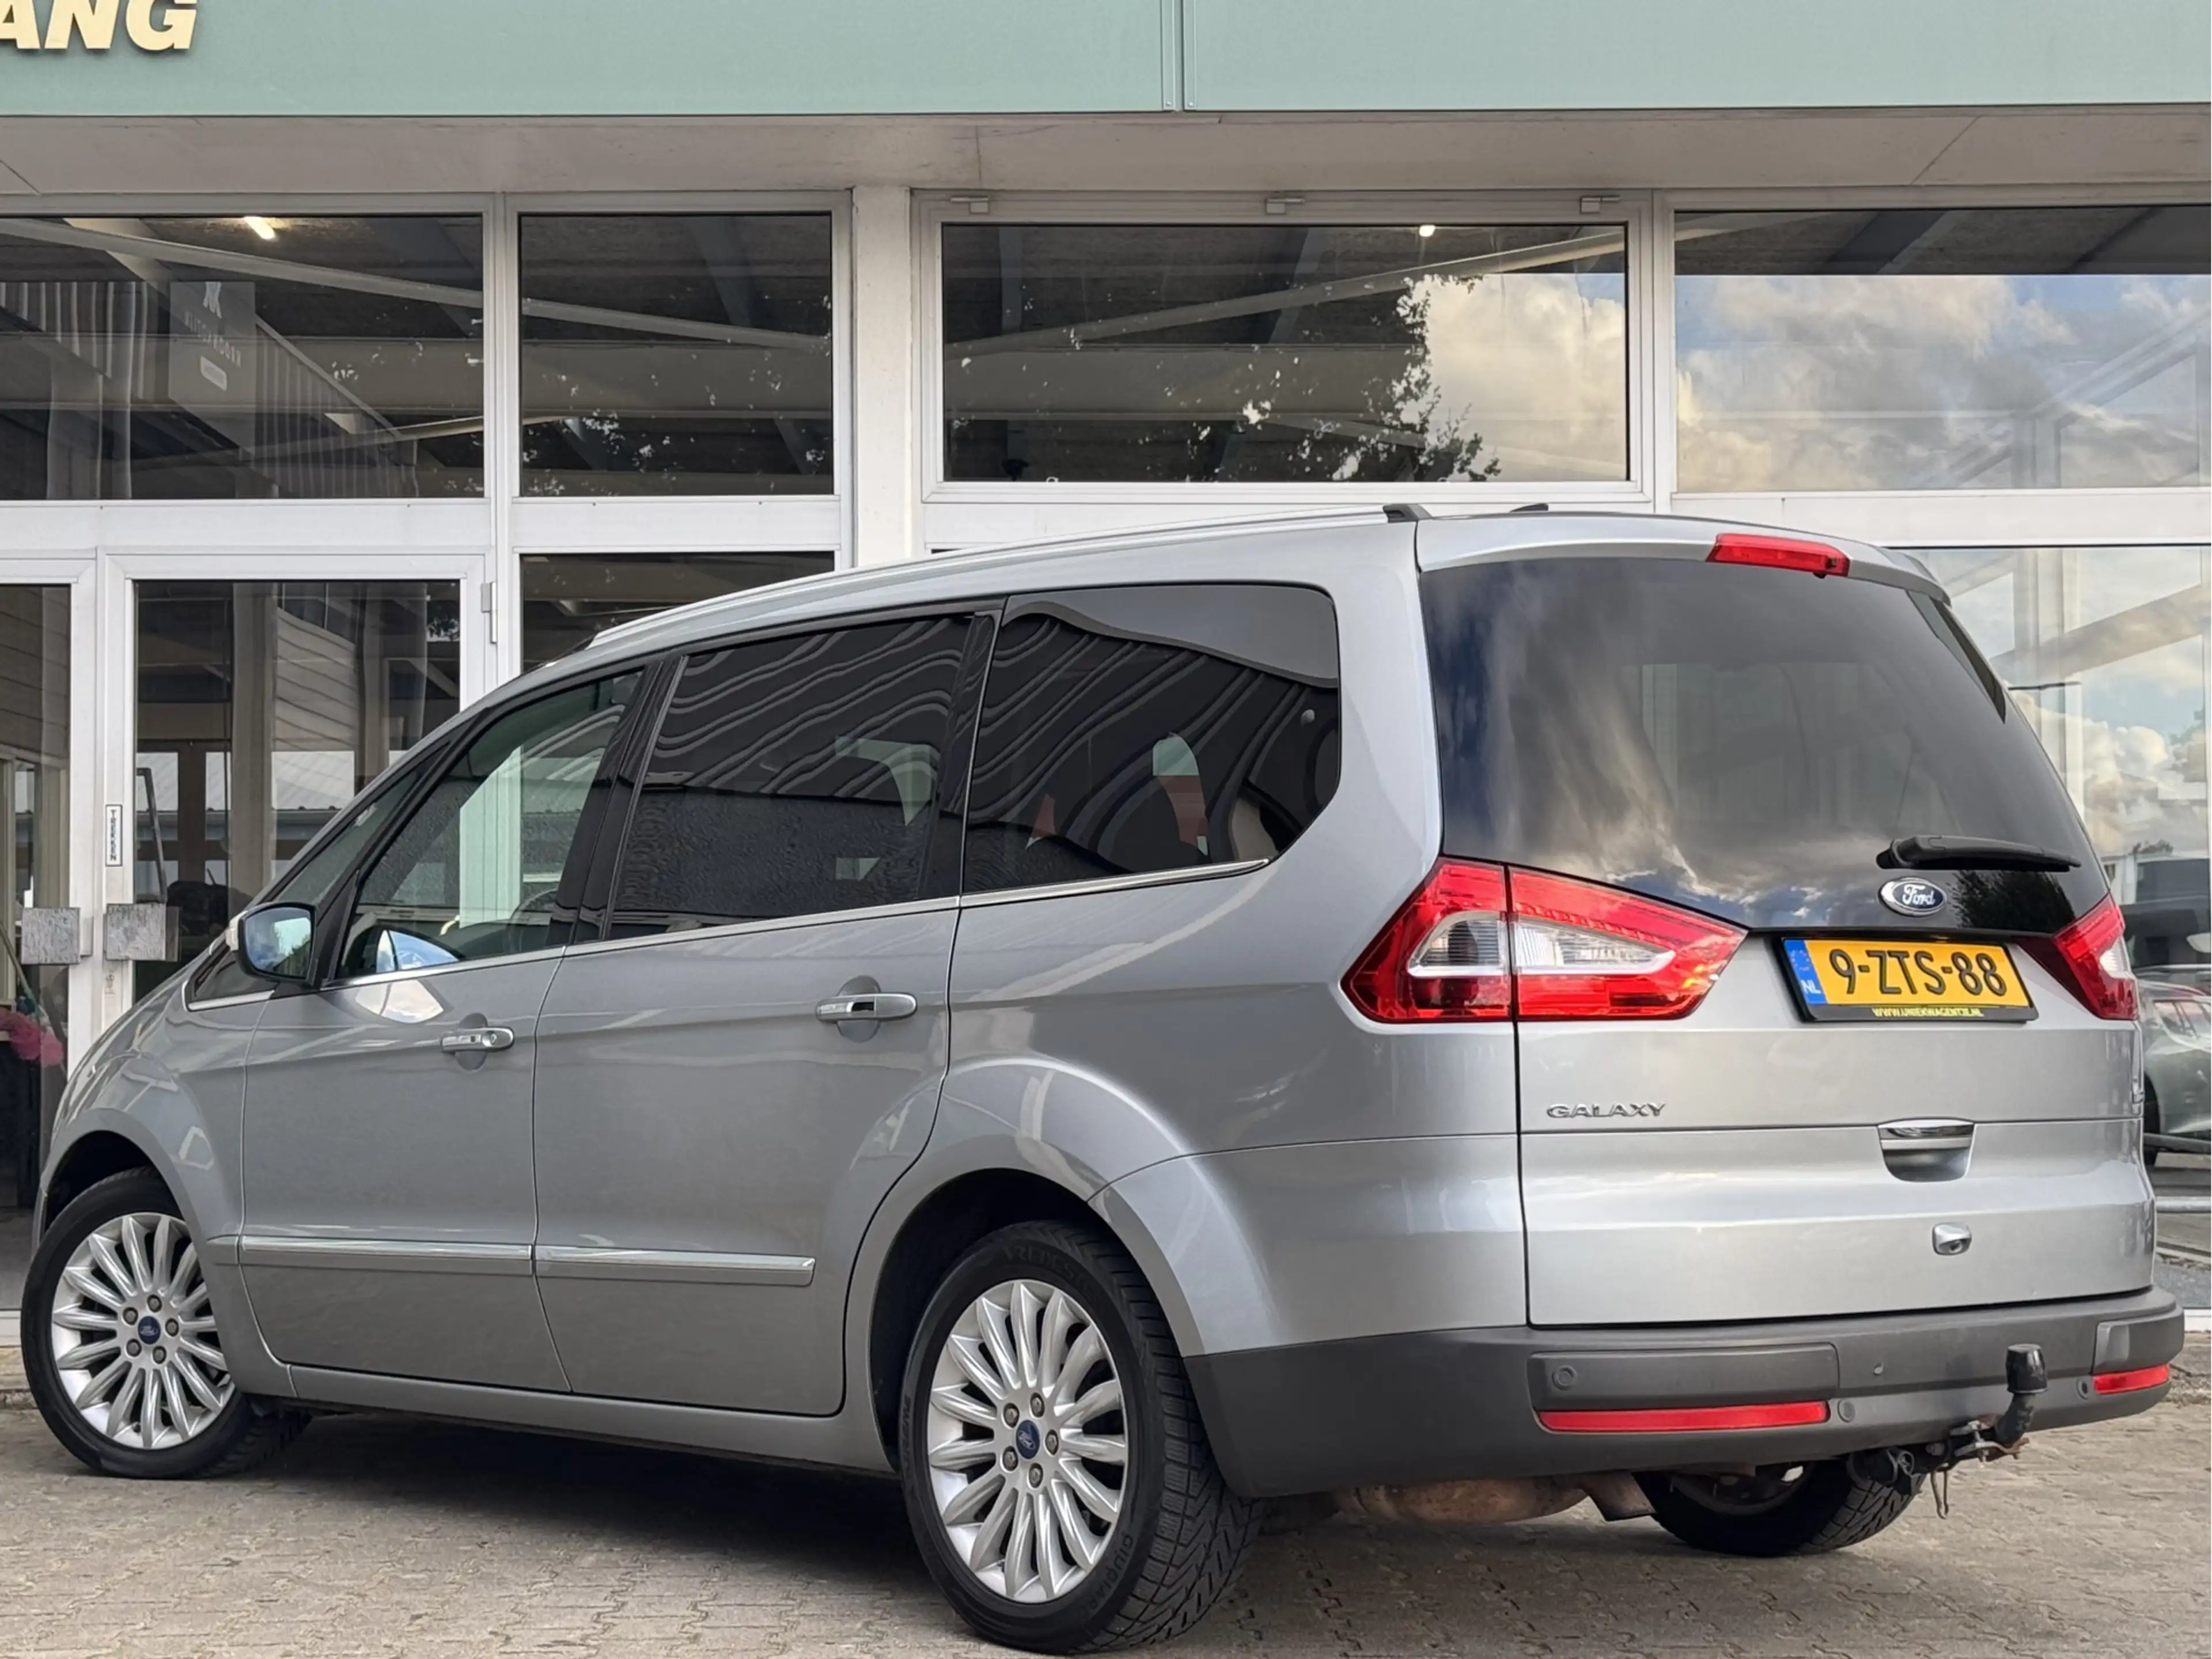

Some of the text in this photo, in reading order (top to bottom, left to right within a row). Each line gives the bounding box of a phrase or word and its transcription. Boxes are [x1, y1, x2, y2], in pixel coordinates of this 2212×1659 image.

[0, 0, 197, 50] ANG
[1902, 884, 1936, 905] Ford
[1829, 949, 2007, 996] 9-ZTS-88
[1801, 979, 1821, 994] NL
[1547, 1101, 1666, 1118] GALAXY
